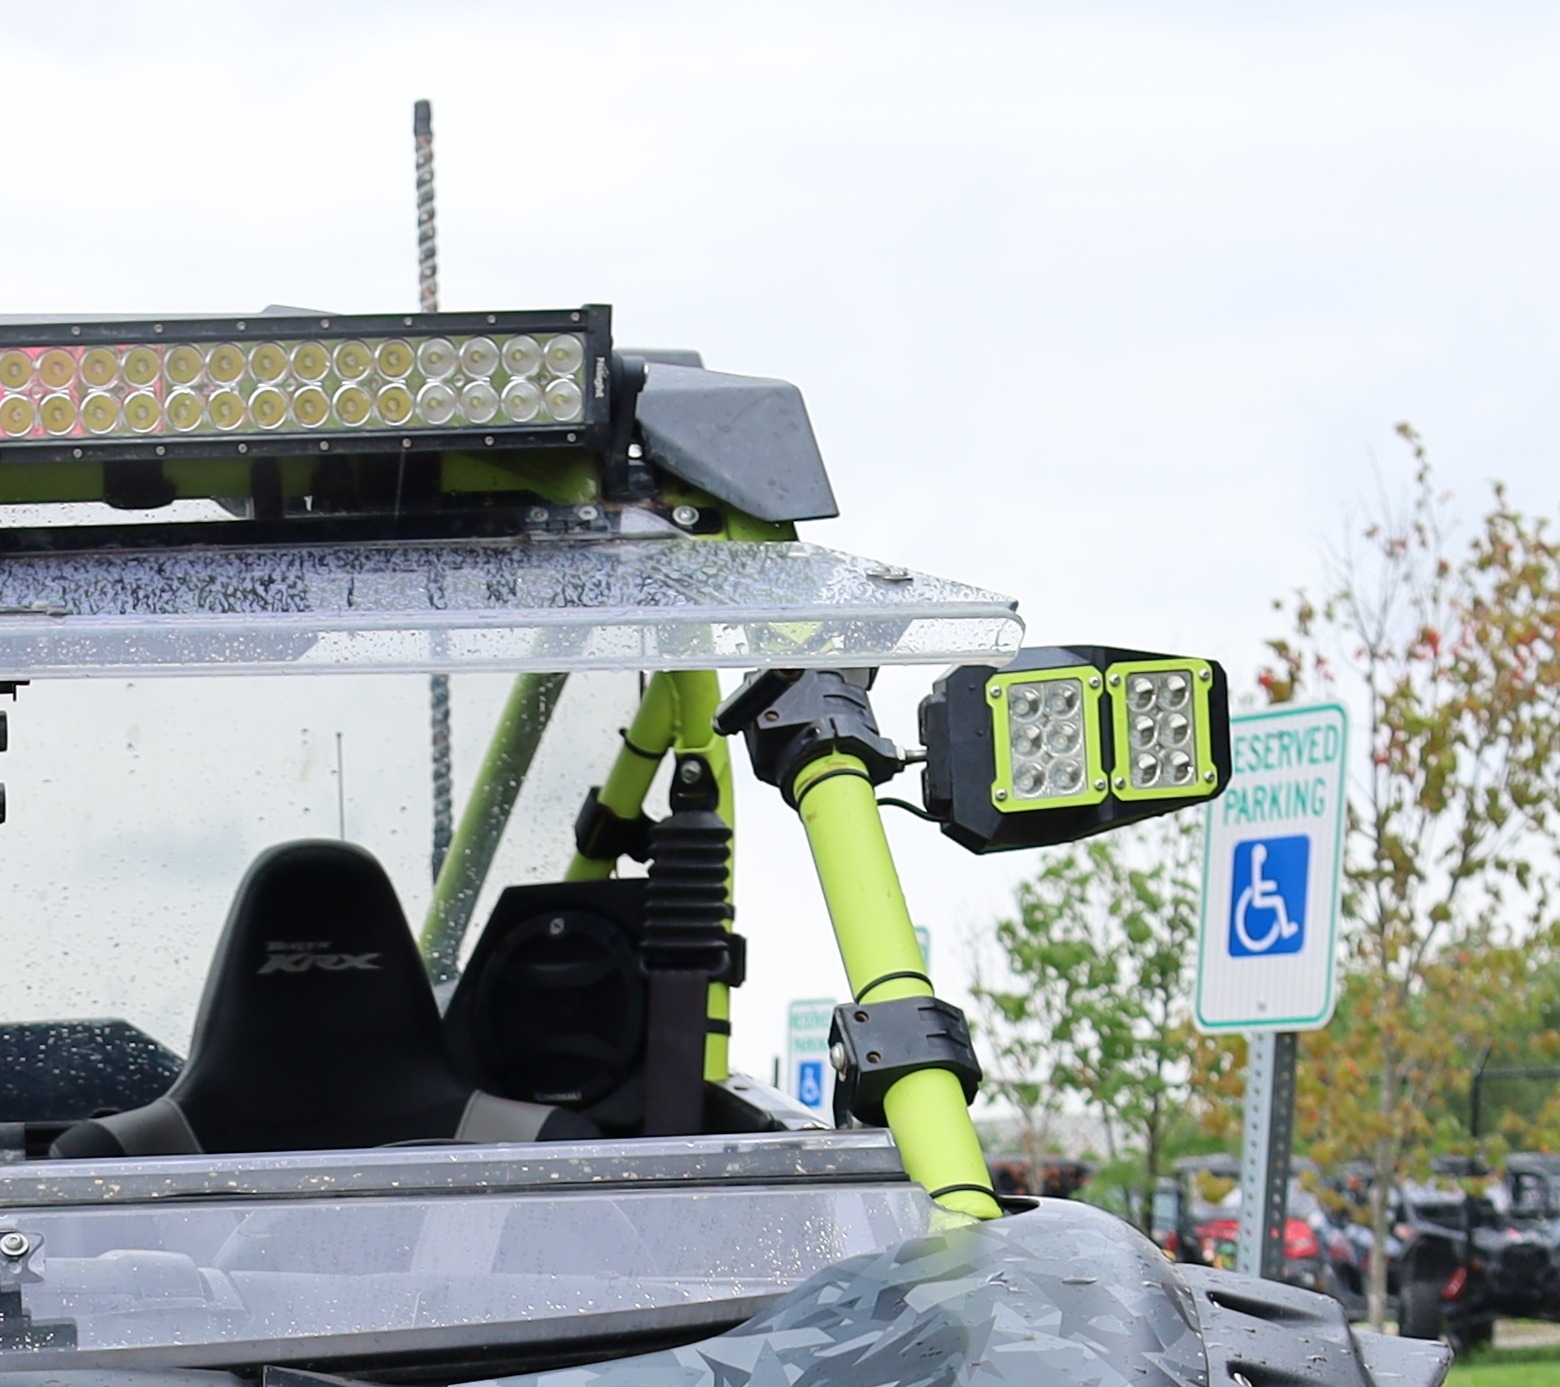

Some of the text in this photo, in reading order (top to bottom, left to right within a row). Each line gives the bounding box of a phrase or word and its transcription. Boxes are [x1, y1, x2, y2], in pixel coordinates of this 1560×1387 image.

[1233, 724, 1339, 774] ESERVED
[1223, 778, 1326, 826] PARKING
[256, 953, 383, 975] KRX
